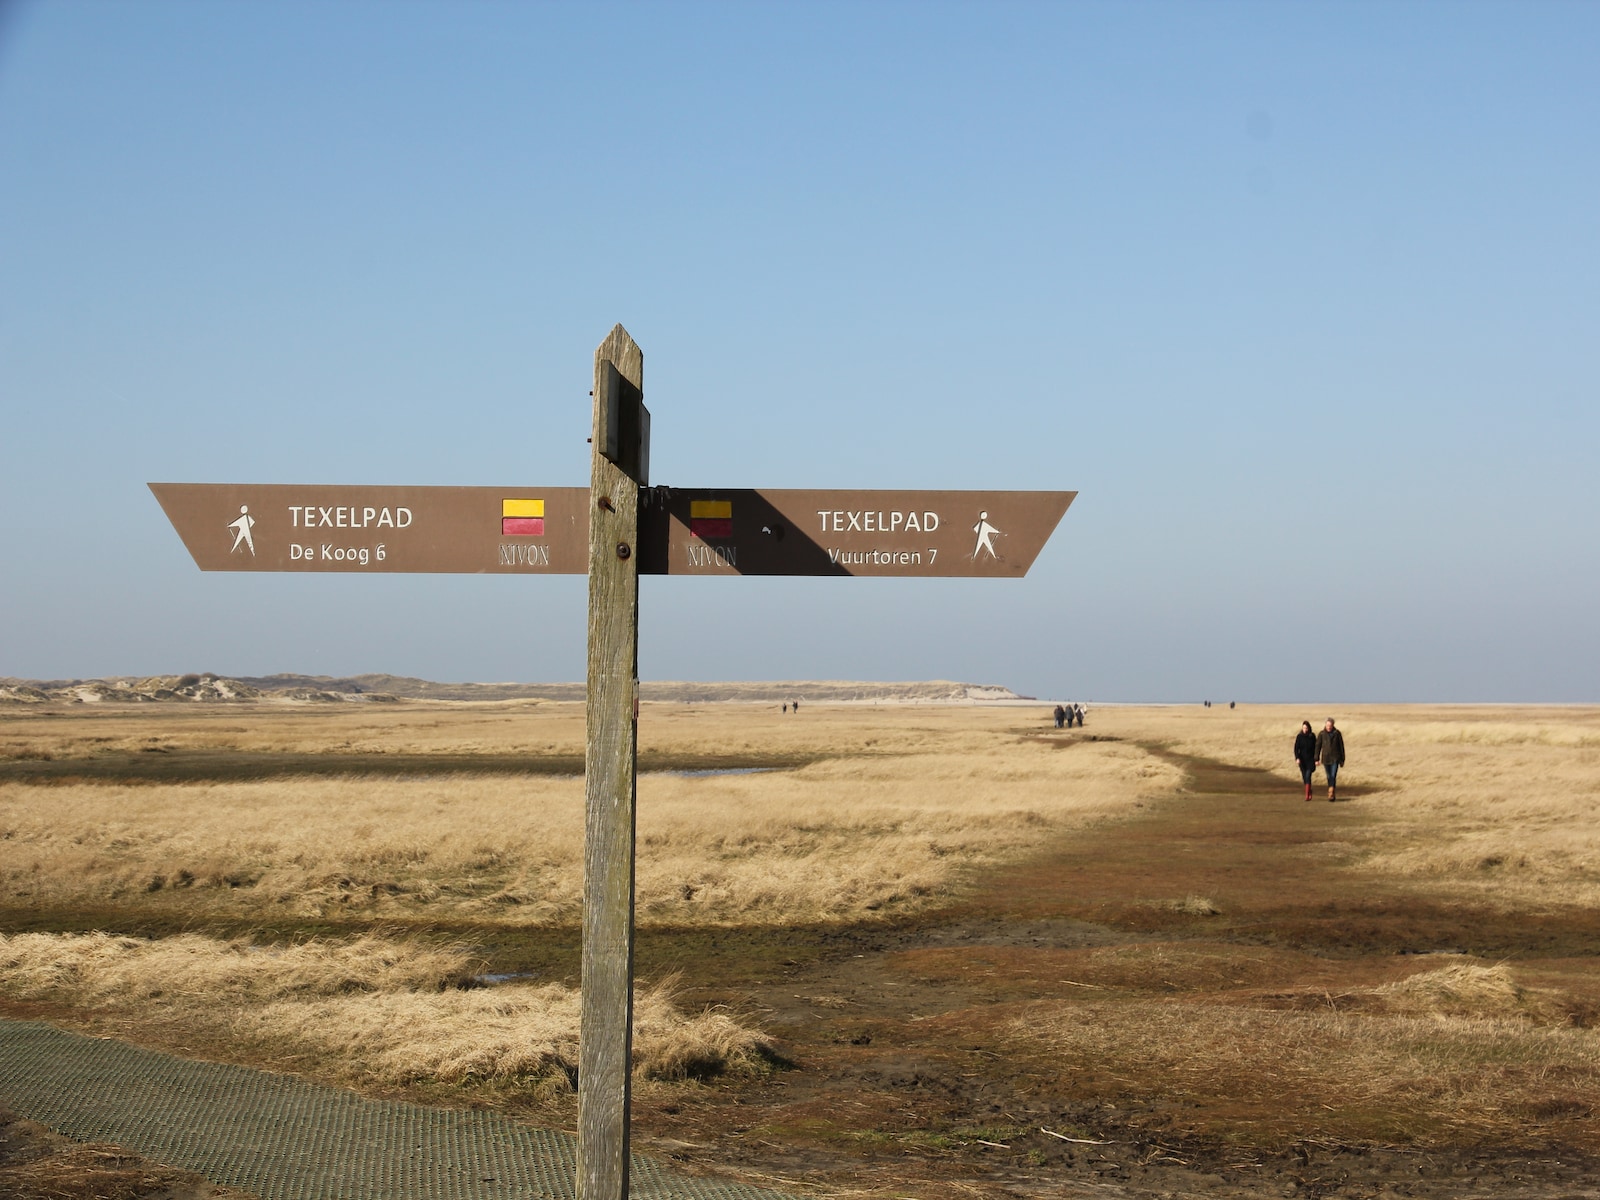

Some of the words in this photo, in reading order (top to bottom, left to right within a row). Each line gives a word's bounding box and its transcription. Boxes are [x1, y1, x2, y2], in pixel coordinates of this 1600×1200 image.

[288, 506, 413, 528] TEXELPAD
[817, 510, 939, 532] TEXELPAD
[289, 543, 314, 560] De
[320, 543, 370, 565] Koog
[376, 543, 386, 561] 6
[499, 543, 549, 565] NIVON
[687, 545, 737, 567] NIVON
[827, 548, 921, 565] Vuurtoren
[928, 549, 938, 565] 7
